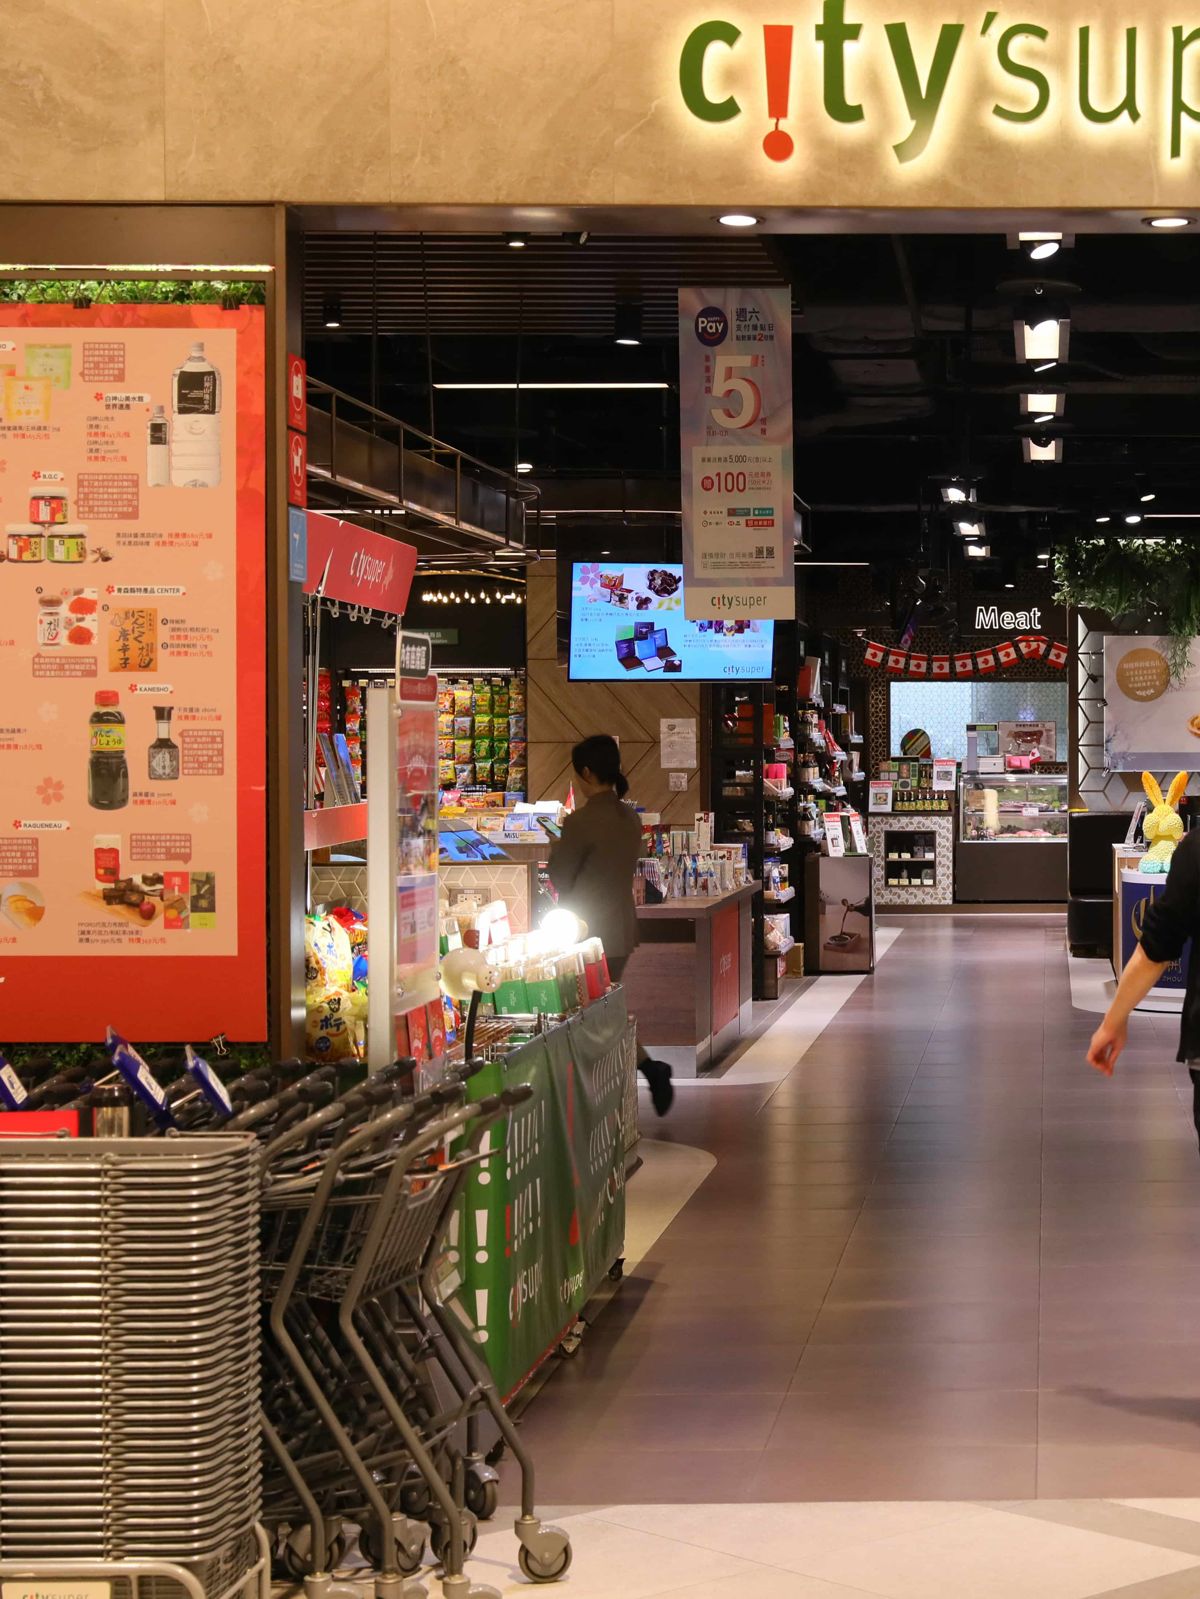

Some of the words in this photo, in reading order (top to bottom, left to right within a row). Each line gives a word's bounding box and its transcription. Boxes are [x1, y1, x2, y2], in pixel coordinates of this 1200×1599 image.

[698, 317, 724, 334] Pay
[735, 307, 760, 322] 週六
[710, 355, 762, 429] 5
[715, 471, 747, 493] 100
[975, 606, 1042, 630] Meat
